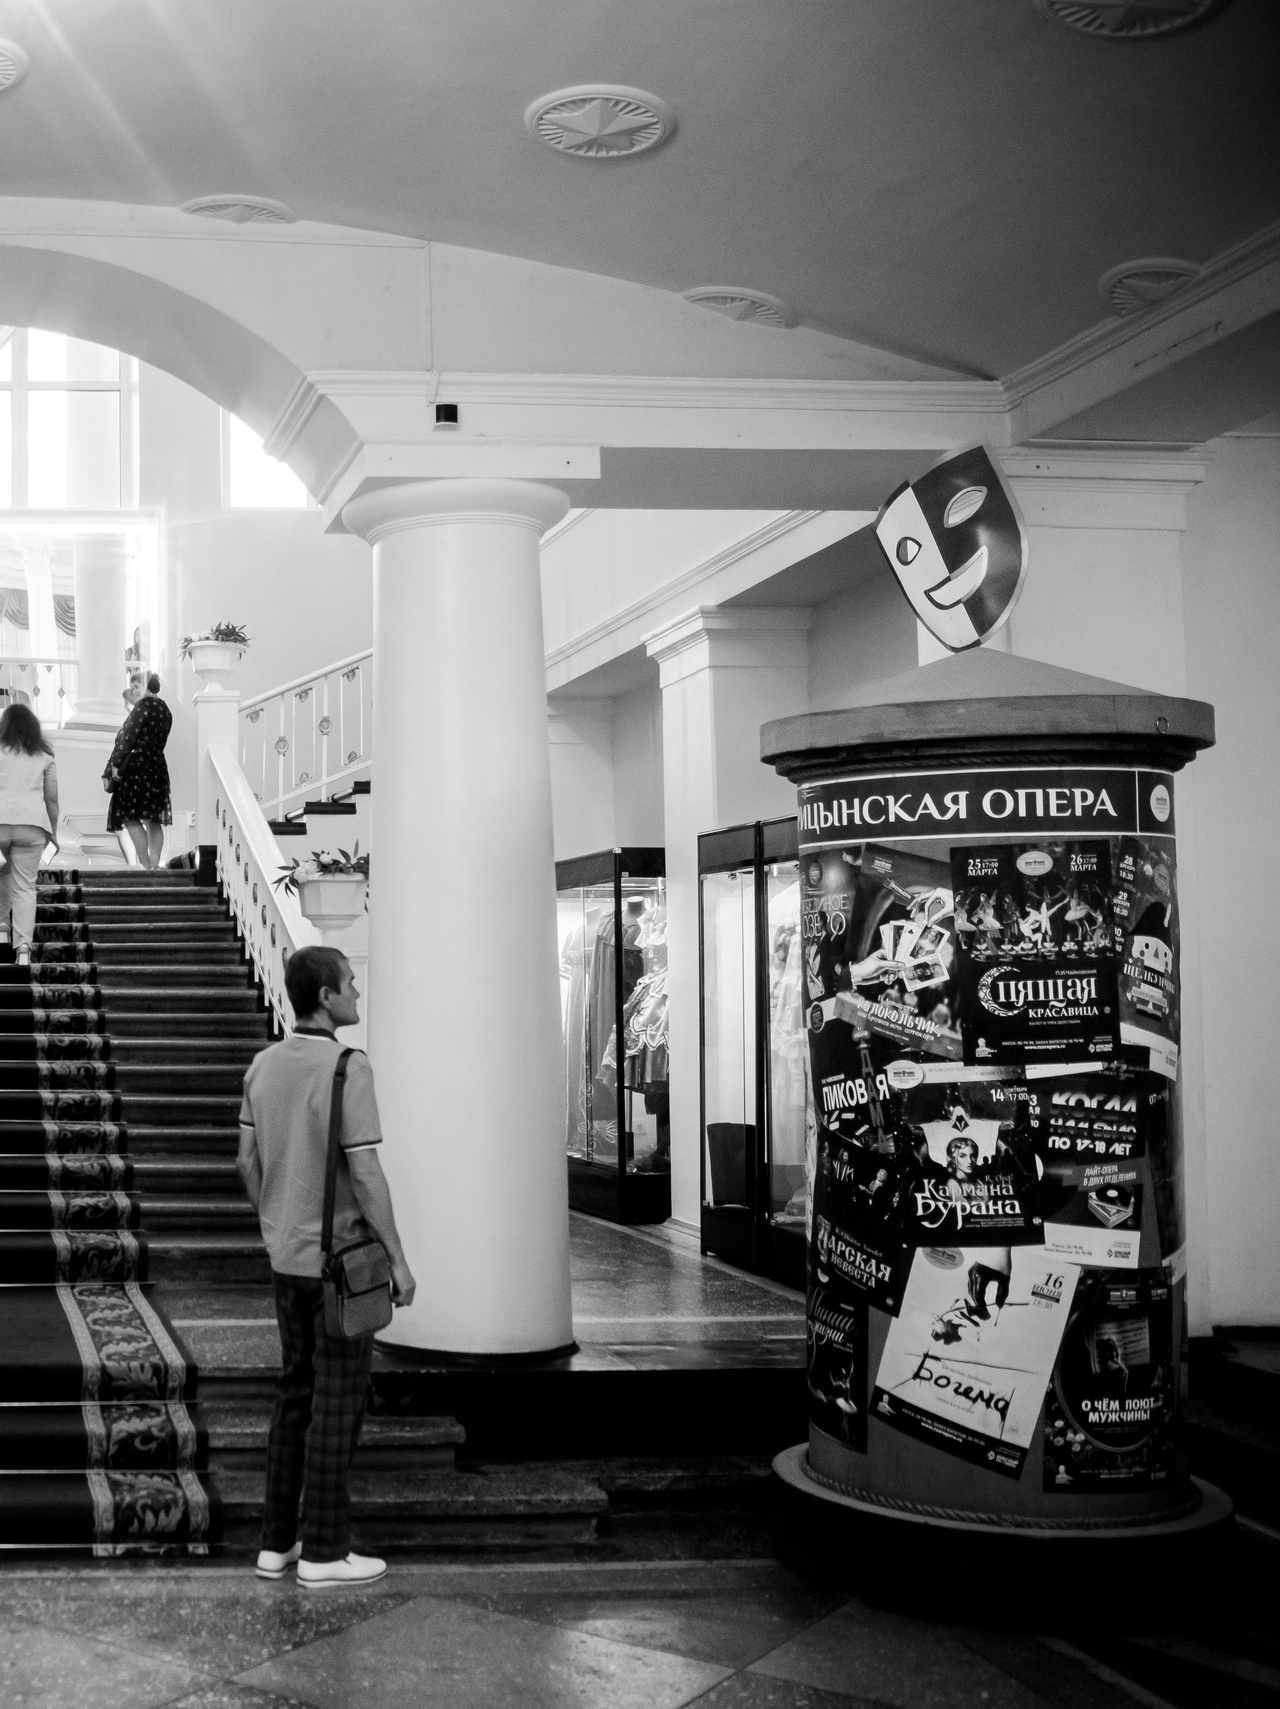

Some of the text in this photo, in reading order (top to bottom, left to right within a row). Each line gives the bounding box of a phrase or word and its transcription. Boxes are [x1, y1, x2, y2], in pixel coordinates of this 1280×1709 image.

[982, 788, 1118, 818] ОПЕРА
[967, 858, 981, 870] 25
[1070, 854, 1083, 865] 26
[1124, 855, 1134, 866] 28
[967, 868, 999, 877] МАРТА
[1070, 864, 1098, 872] МАРТА
[1118, 891, 1128, 901] 29
[1028, 1006, 1099, 1018] КРАСАВИЦА
[990, 1088, 1005, 1102] 14
[1048, 1135, 1133, 1156] ПО 17-18 ЛЕТ
[1084, 1165, 1119, 1177] ЛАЙТ-ОПЕРА
[1083, 1171, 1137, 1187] В ДВУХ ОТДЕЛЕНИЯХ
[914, 1192, 1022, 1231] Бурана
[1042, 1273, 1065, 1290] 16
[1032, 1284, 1063, 1299] ИЮНЯ
[1081, 1397, 1155, 1412] О ЧЁМ ПОЮТ
[1088, 1409, 1150, 1424] МУЖЧИНЫ
